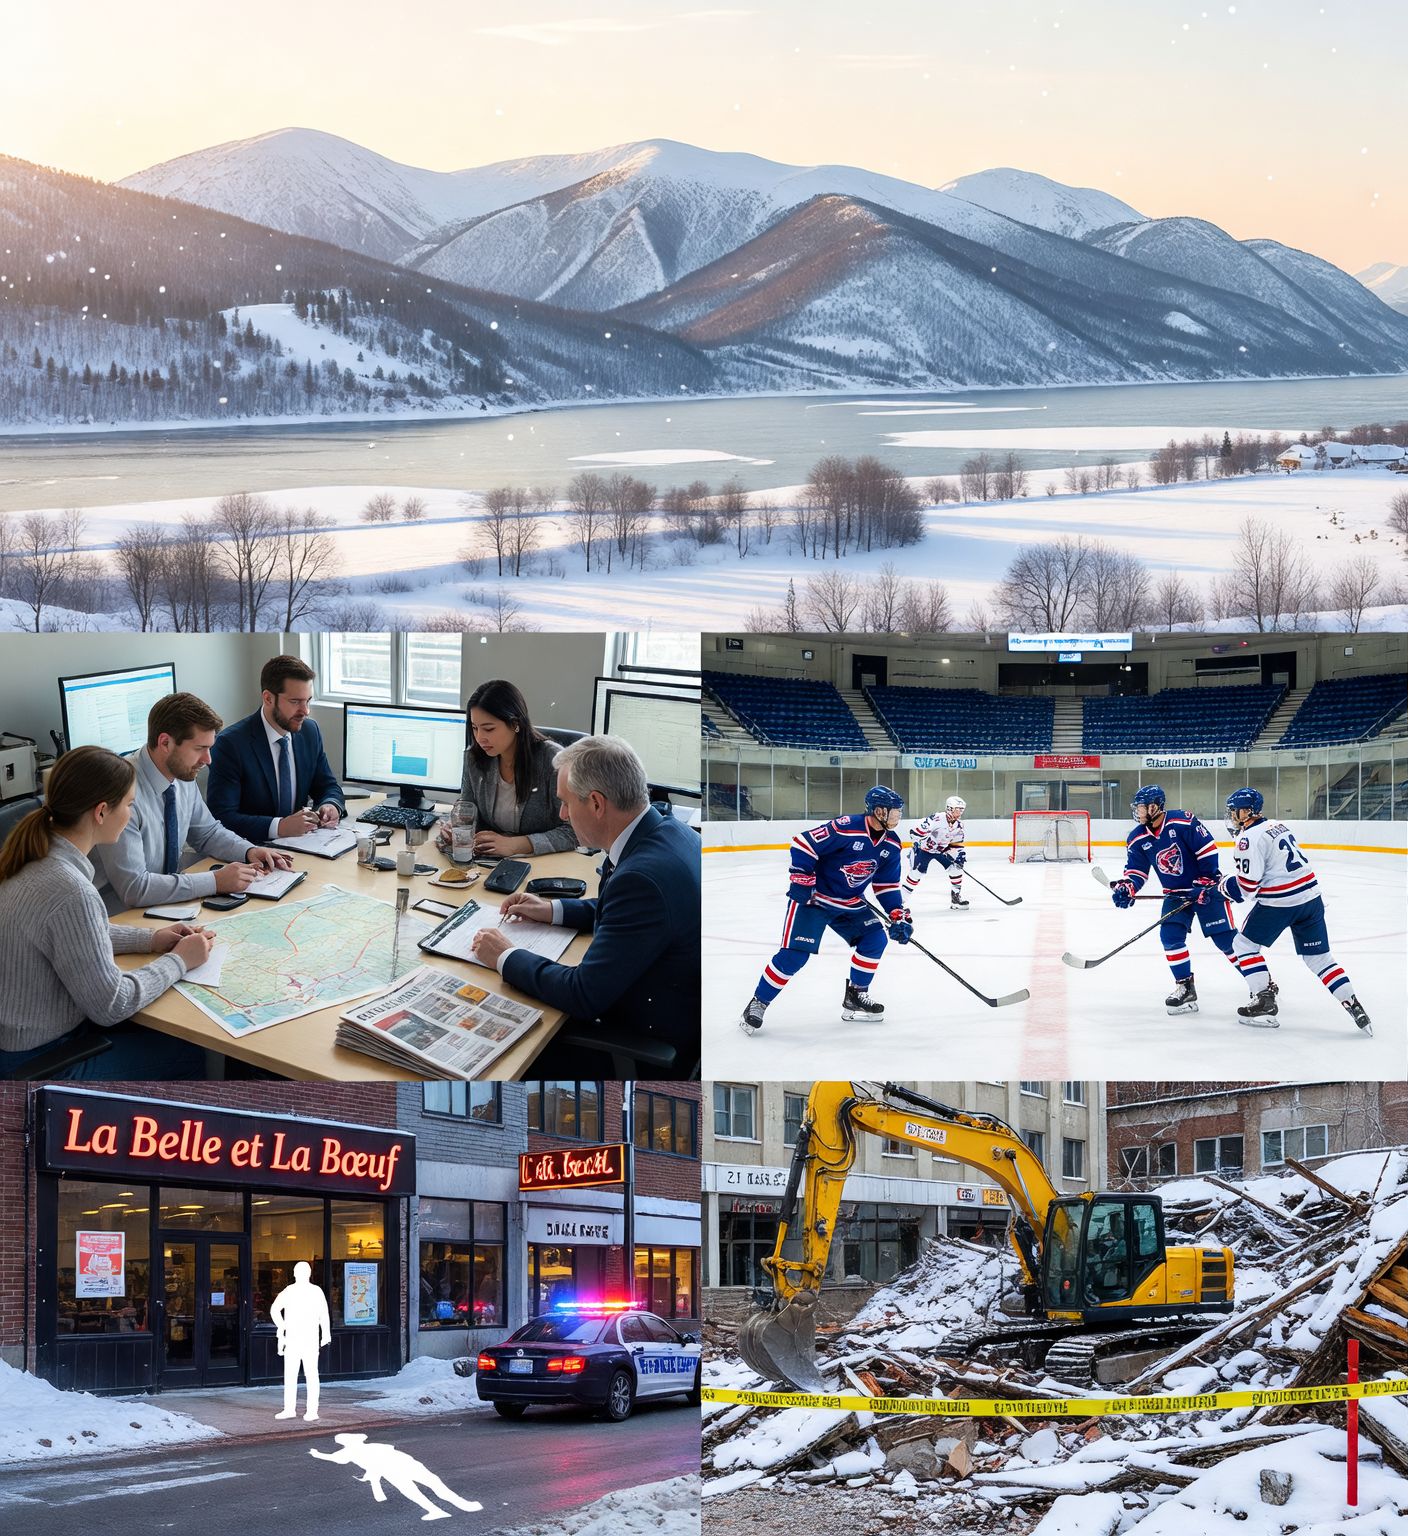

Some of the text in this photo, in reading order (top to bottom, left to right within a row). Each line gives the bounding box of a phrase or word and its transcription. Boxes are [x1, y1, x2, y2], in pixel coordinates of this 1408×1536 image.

[64, 1109, 402, 1191] La Belle et La Bœuf
